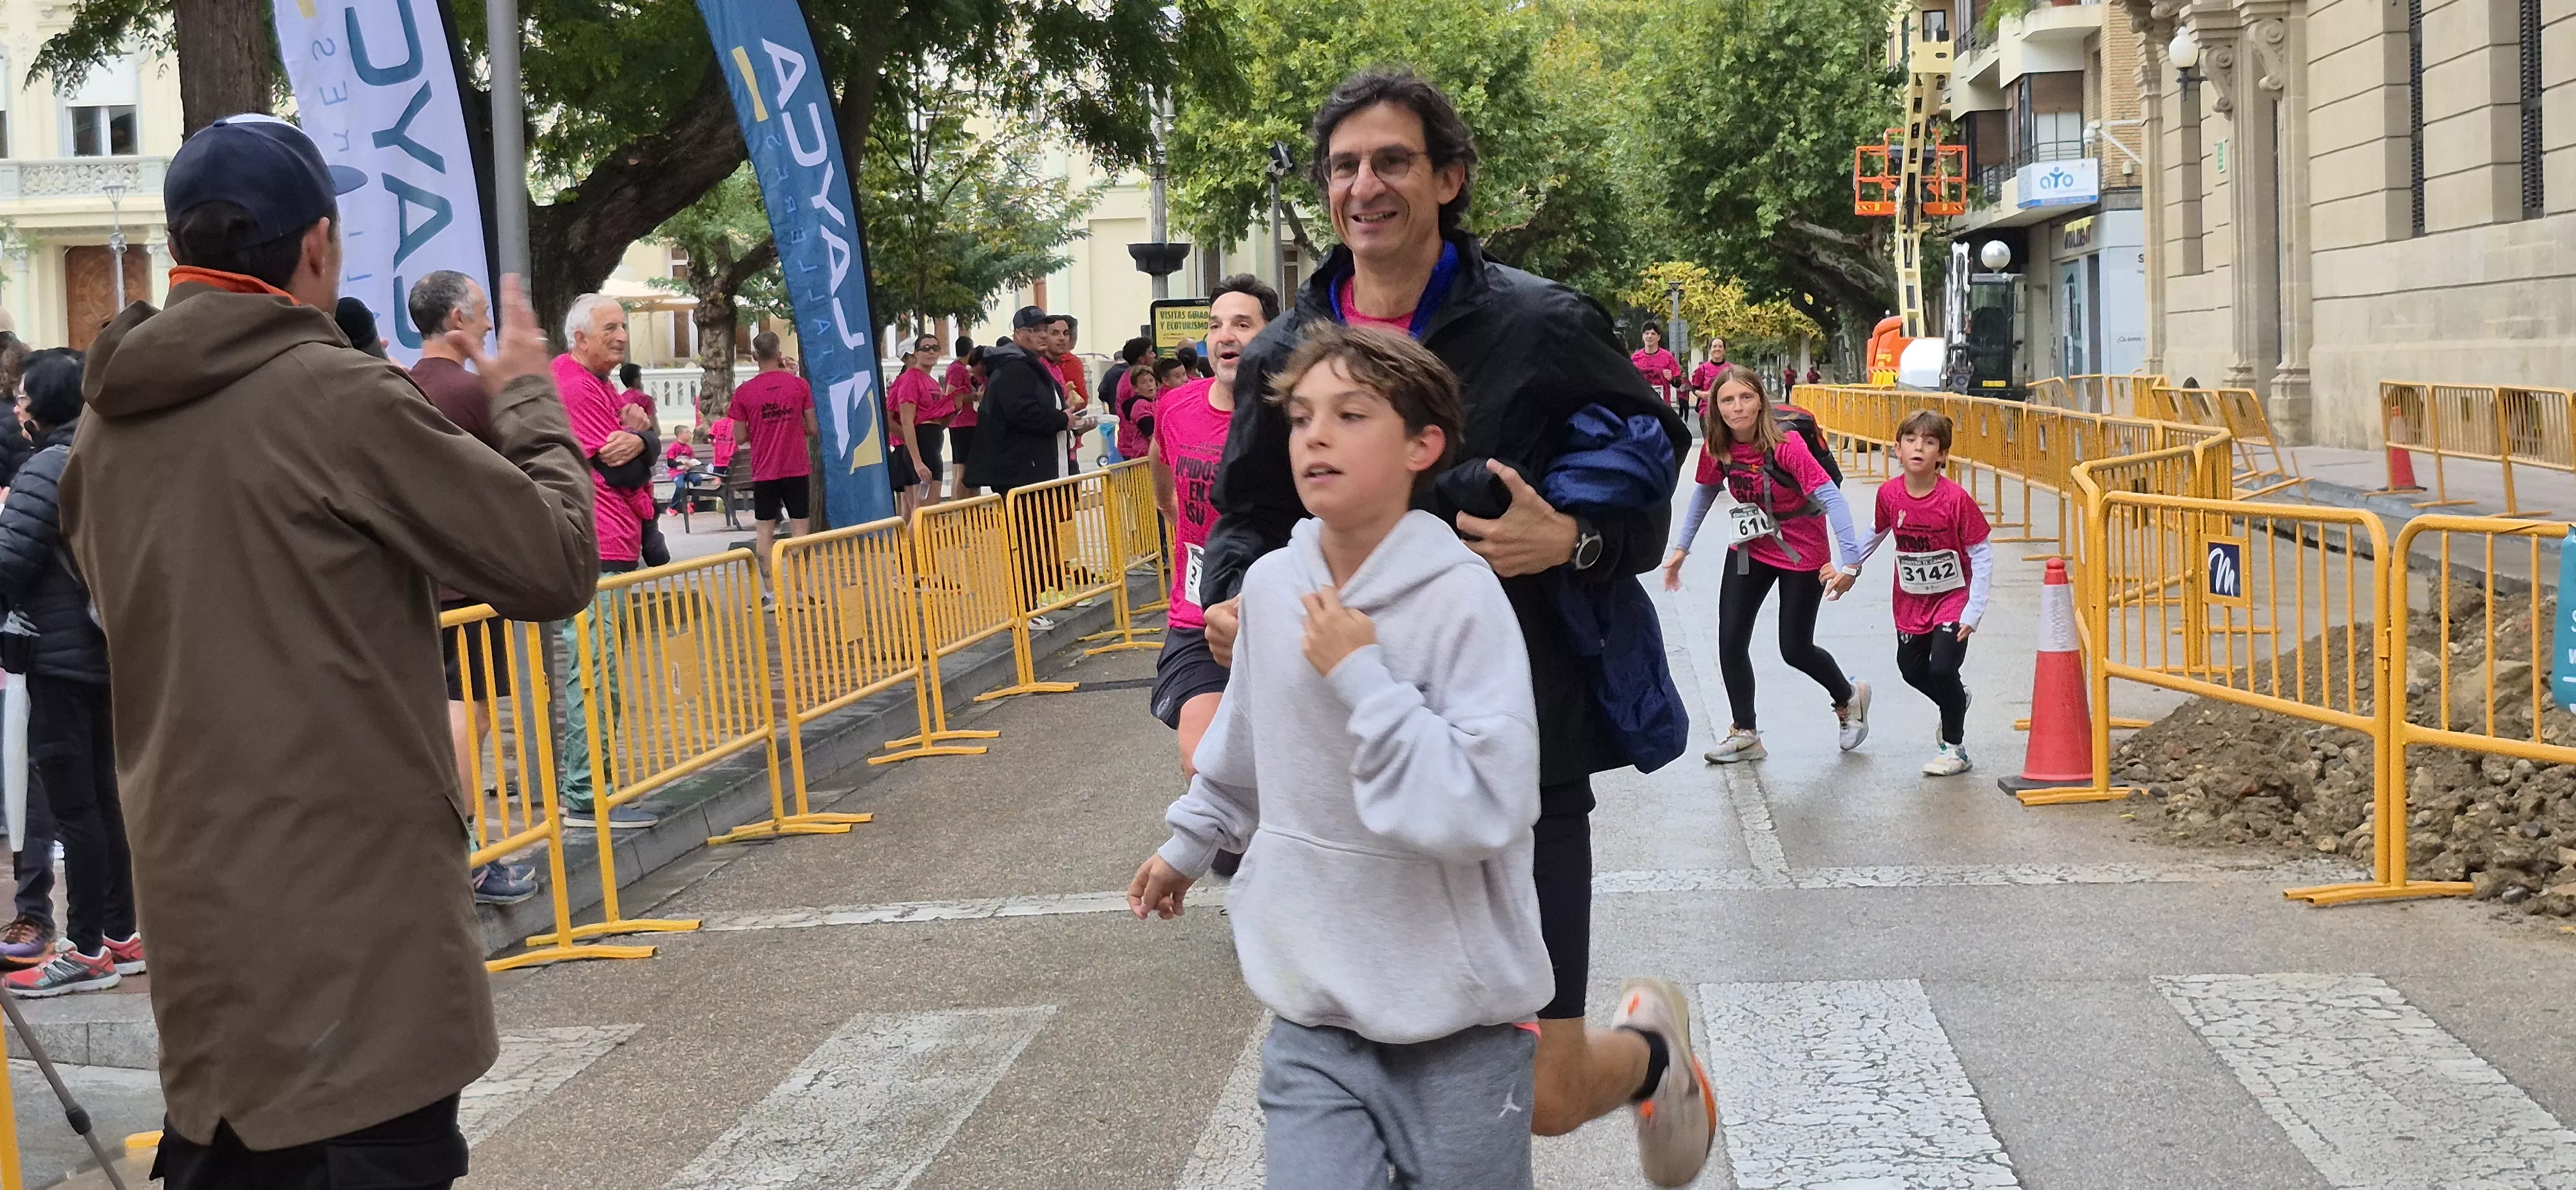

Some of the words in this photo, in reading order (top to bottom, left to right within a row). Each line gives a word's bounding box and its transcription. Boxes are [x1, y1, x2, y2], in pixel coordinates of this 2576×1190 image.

[1160, 310, 1186, 320] VISITAS
[1188, 310, 1209, 319] GUIAD
[1160, 321, 1165, 330] Y
[1167, 321, 1209, 330] ECOTURISMO
[1189, 480, 1206, 502] EN
[1902, 562, 1956, 582] 3142
